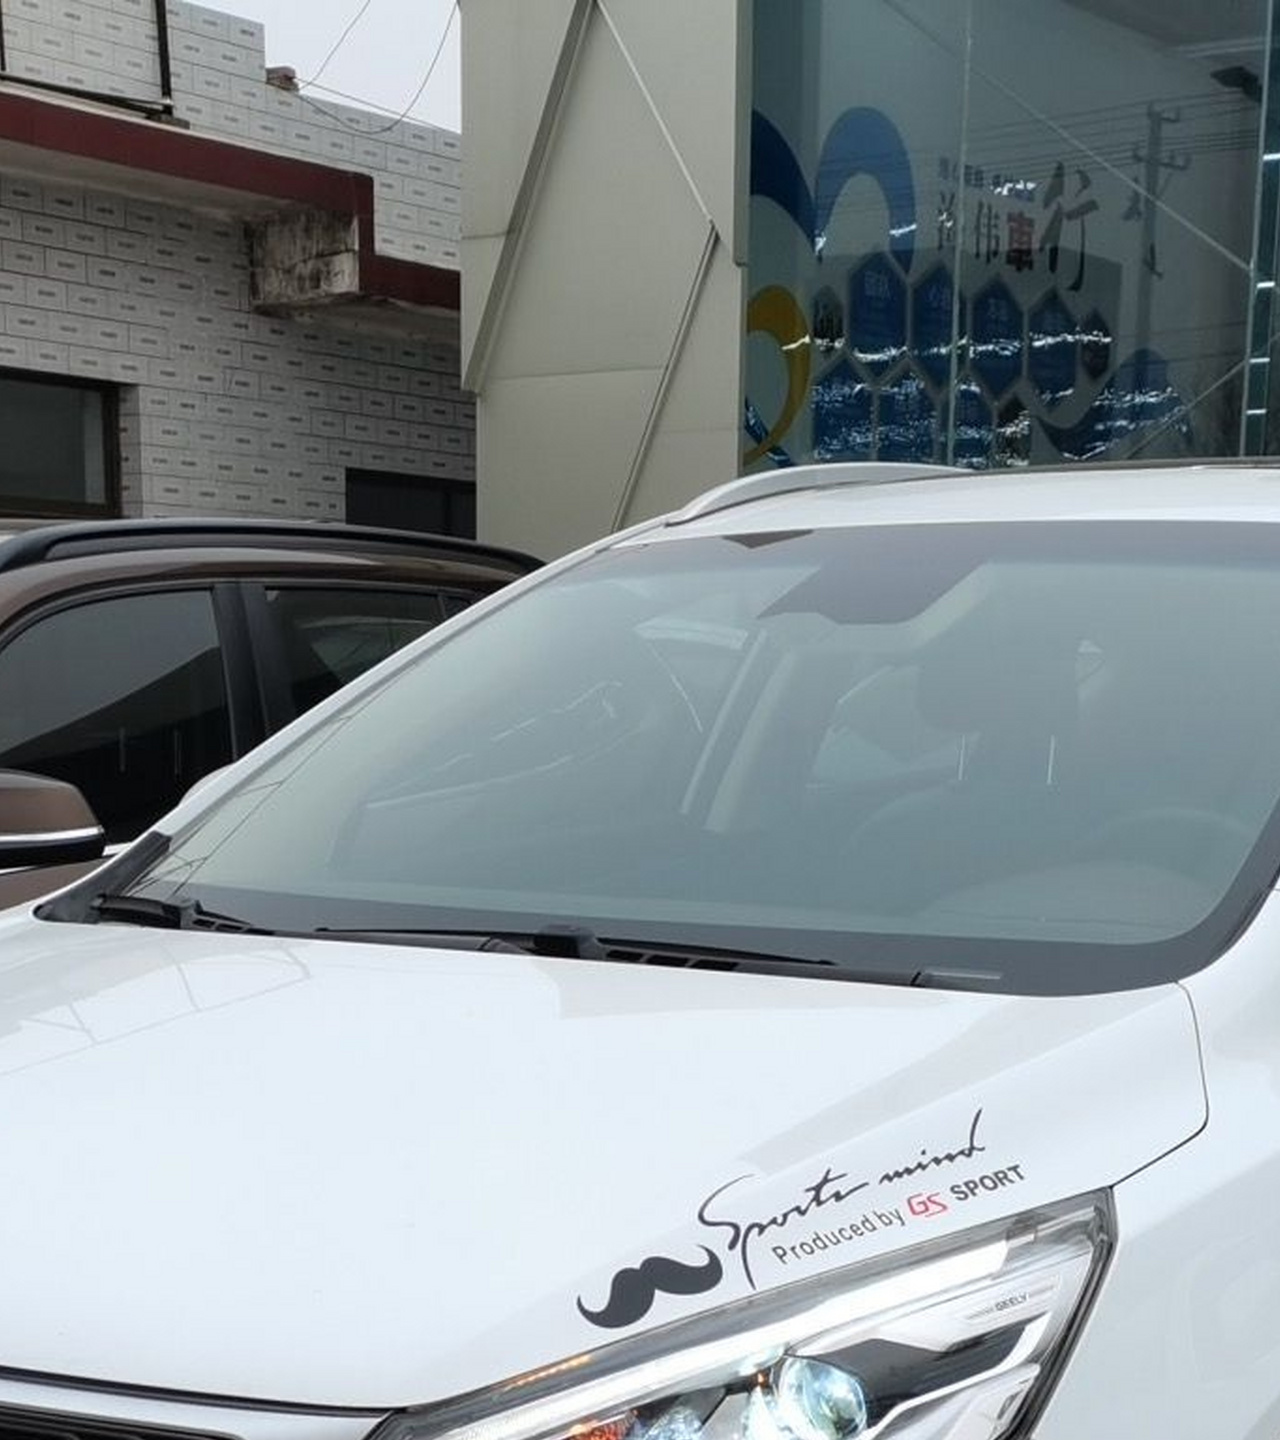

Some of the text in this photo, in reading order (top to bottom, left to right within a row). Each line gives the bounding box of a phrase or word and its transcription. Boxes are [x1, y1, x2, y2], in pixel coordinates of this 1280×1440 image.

[697, 1107, 986, 1291] Sports mind
[771, 1164, 1026, 1265] Produced by GS SPORT
[994, 1292, 1030, 1313] GEELY
